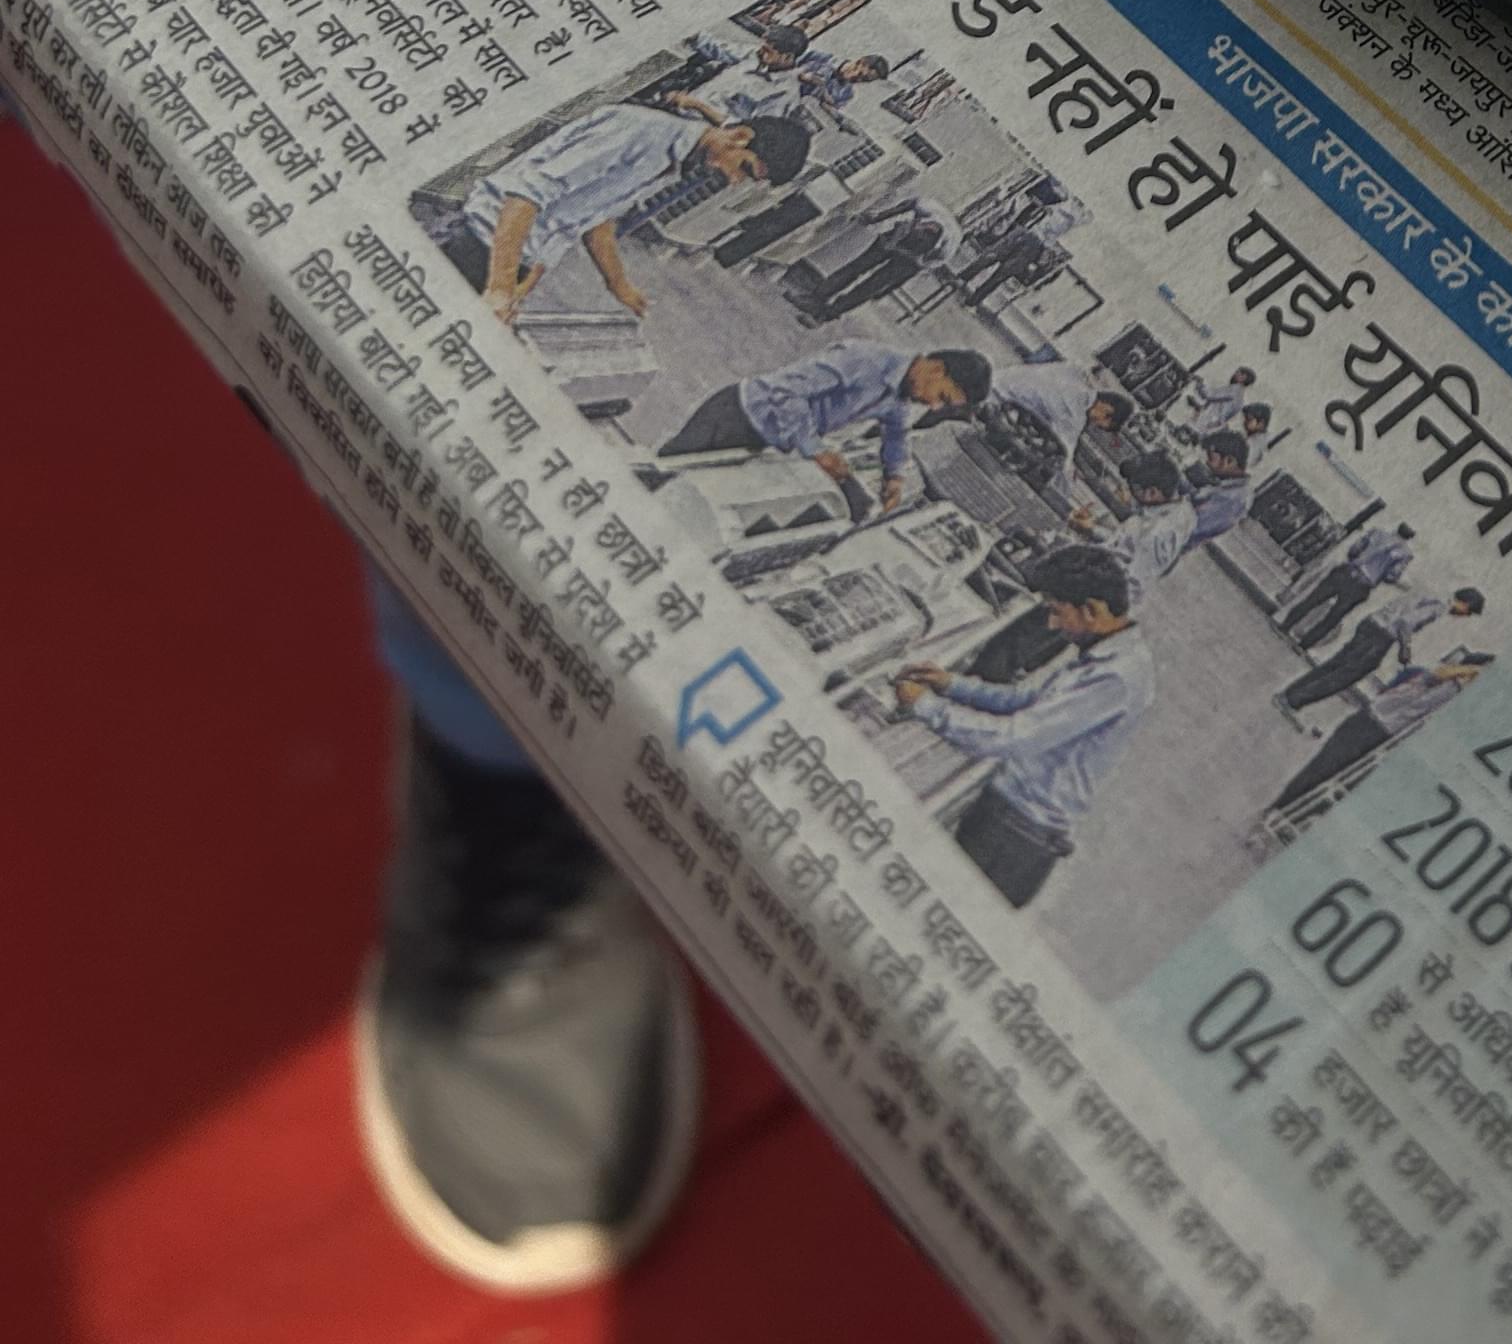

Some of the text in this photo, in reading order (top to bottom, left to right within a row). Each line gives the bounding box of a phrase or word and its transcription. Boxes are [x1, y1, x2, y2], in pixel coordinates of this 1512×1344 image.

[533, 27, 573, 66] है।
[1390, 51, 1421, 81] के
[1419, 78, 1471, 127] मध्य
[1026, 23, 1175, 155] नहीं
[1128, 136, 1238, 232] हो
[1227, 209, 1376, 353] पाई
[1207, 35, 1320, 140] भाजपा
[1311, 130, 1436, 250] सरकार
[1430, 236, 1483, 289] के
[343, 224, 705, 633] आयोजित किया गया, न ही छात्रों को
[1291, 879, 1403, 989] 60
[1187, 969, 1304, 1093] 04
